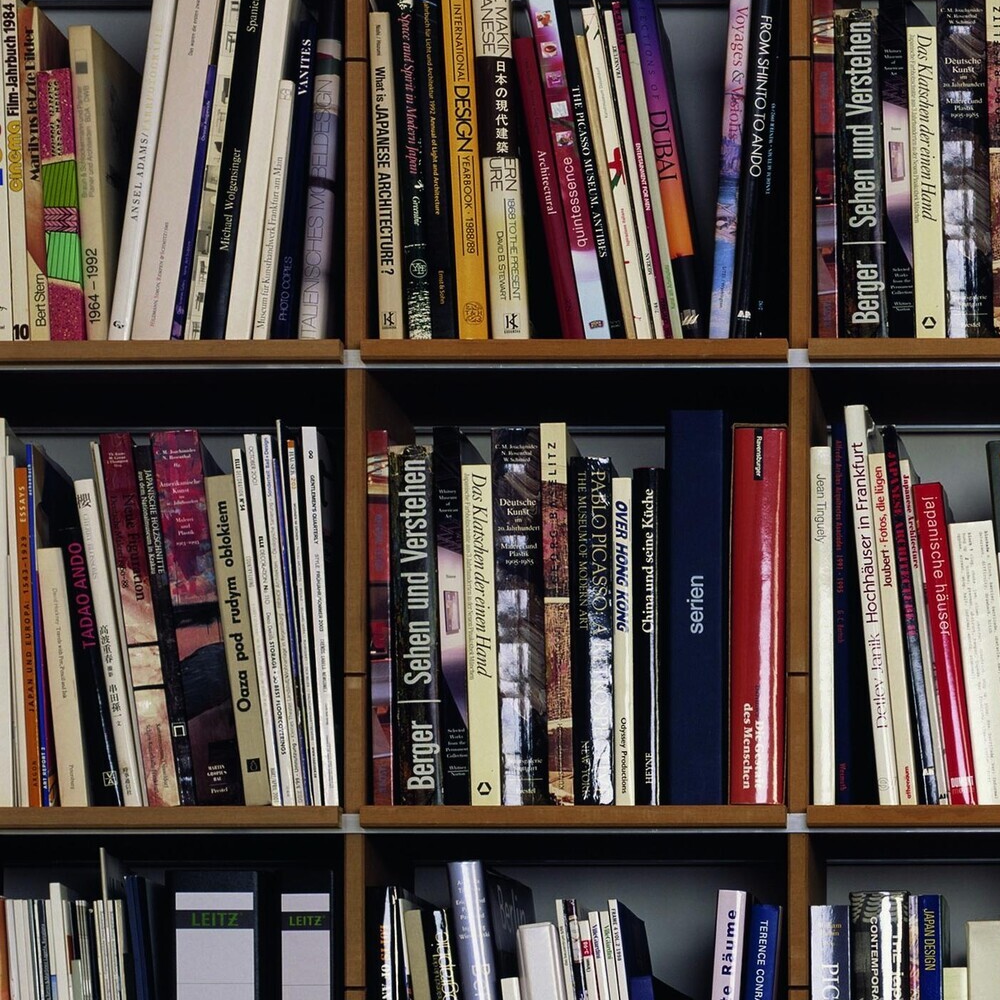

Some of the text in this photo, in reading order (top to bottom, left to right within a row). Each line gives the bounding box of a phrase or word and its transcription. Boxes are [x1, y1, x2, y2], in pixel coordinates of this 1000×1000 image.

[2, 4, 14, 34] 1984
[453, 4, 464, 81] INTERNATIONAL
[6, 36, 18, 117] Film-Jahrbuch
[375, 66, 384, 92] What
[750, 16, 772, 178] FROM SHINTO TO ANDO
[375, 104, 390, 169] JAPANESE
[454, 86, 472, 152] DESIGN
[219, 148, 241, 252] Michael Wolgensinger
[461, 156, 472, 210] YEARBOOK
[564, 156, 588, 247] quintessence
[846, 22, 885, 323] Berger Sehen und Verstehen
[378, 174, 394, 264] ARCHITECTURE
[12, 324, 28, 340] 10
[815, 474, 826, 544] Jean Tinguely
[851, 442, 878, 624] Hochhäuser in Frankfurt
[68, 543, 88, 590] ANDO
[615, 500, 628, 632] OVER HONG KONG
[922, 497, 952, 636] japanische häuser
[76, 592, 96, 649] TADAO
[225, 576, 241, 624] rudym
[400, 460, 440, 790] Berger Sehen und Verstehen
[686, 575, 704, 634] serien
[230, 632, 248, 662] pod
[237, 670, 252, 712] Oaza
[192, 912, 239, 926] LEITZ
[289, 916, 322, 926] LEITZ
[924, 908, 935, 970] JAPAN DESIGN
